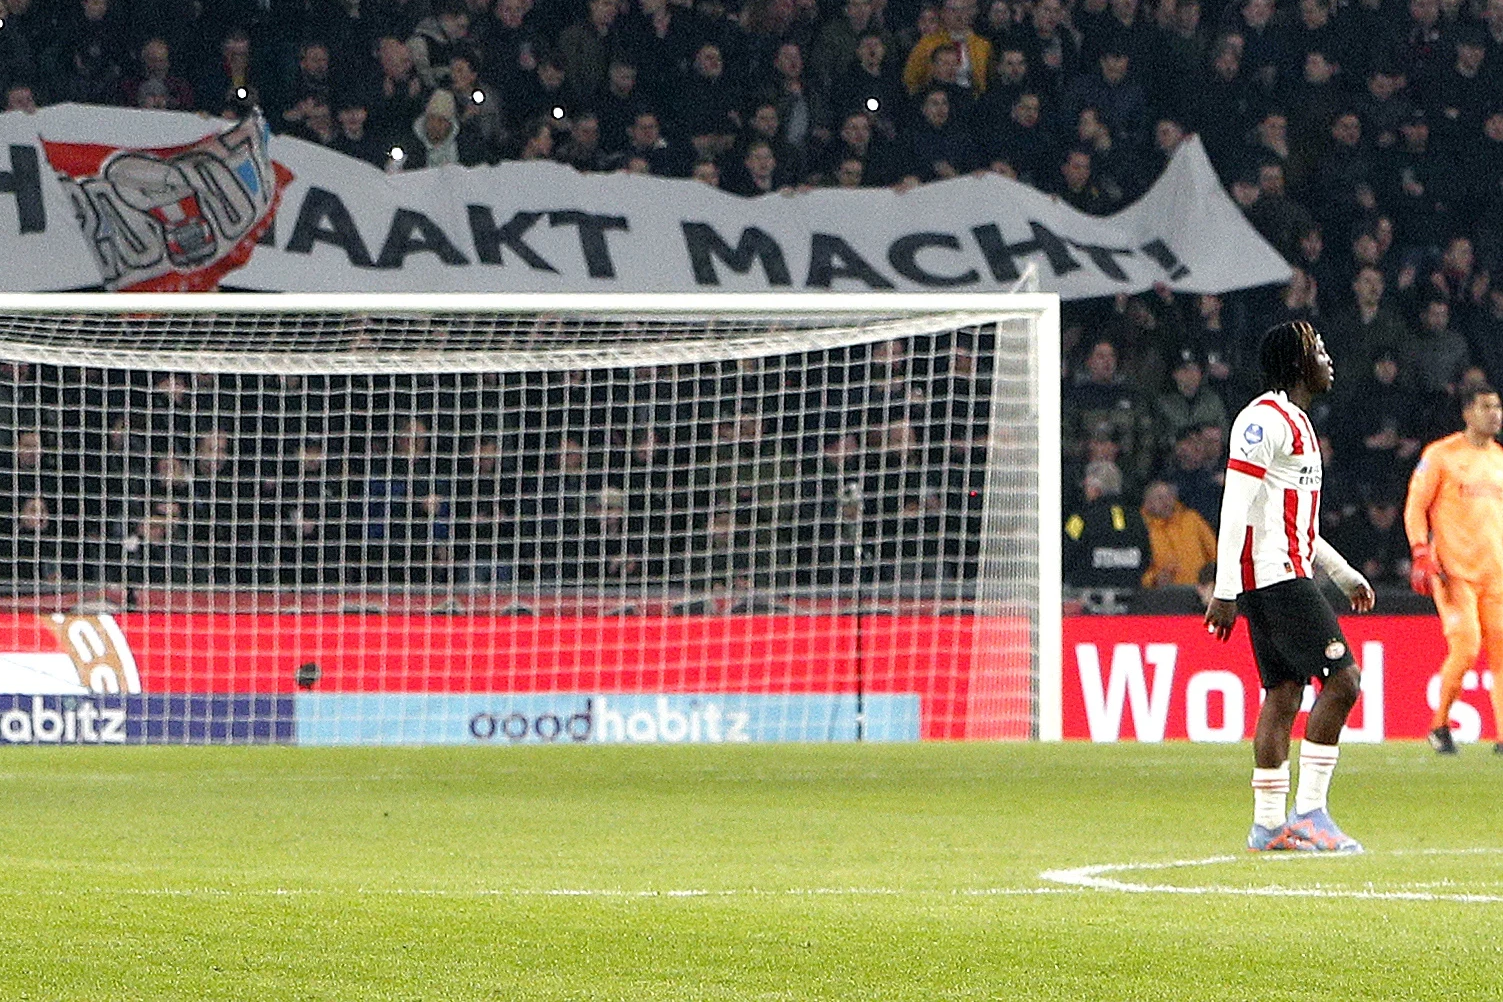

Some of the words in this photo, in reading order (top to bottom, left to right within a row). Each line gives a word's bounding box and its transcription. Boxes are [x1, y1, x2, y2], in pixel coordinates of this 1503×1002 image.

[257, 186, 628, 279] AAKT
[680, 220, 1191, 289] MACHT!
[1076, 642, 1384, 742] Wod
